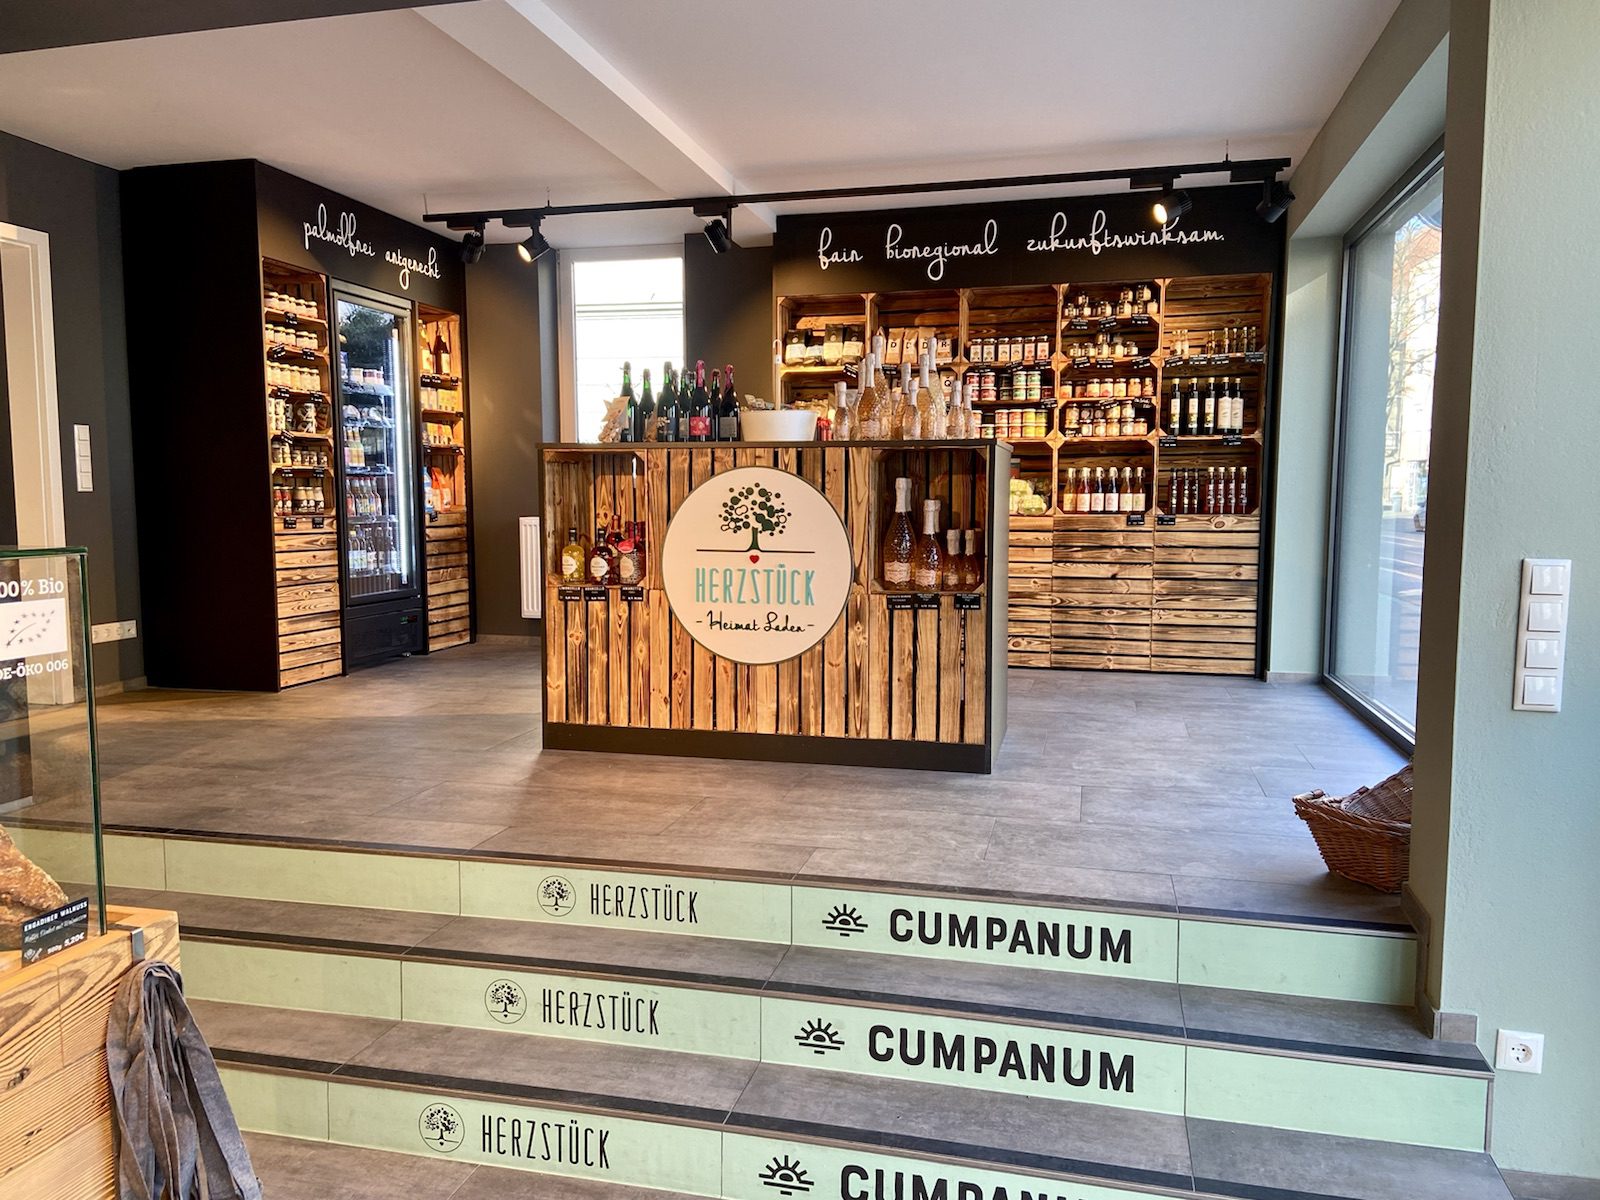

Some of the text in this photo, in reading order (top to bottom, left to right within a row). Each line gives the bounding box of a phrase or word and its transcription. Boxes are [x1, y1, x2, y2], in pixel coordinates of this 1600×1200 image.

[818, 227, 863, 269] fair
[885, 219, 998, 280] bioregional
[38, 577, 64, 595] Bio
[695, 563, 815, 606] HERZSTÜCK
[706, 610, 805, 633] Heimat Laden
[46, 659, 68, 672] 006
[590, 883, 1132, 964] HERZSTÜCK CUMPANUM
[542, 988, 1135, 1093] HERZSTÜCK CUMPANUM
[482, 1115, 610, 1169] HERZSTÜCK
